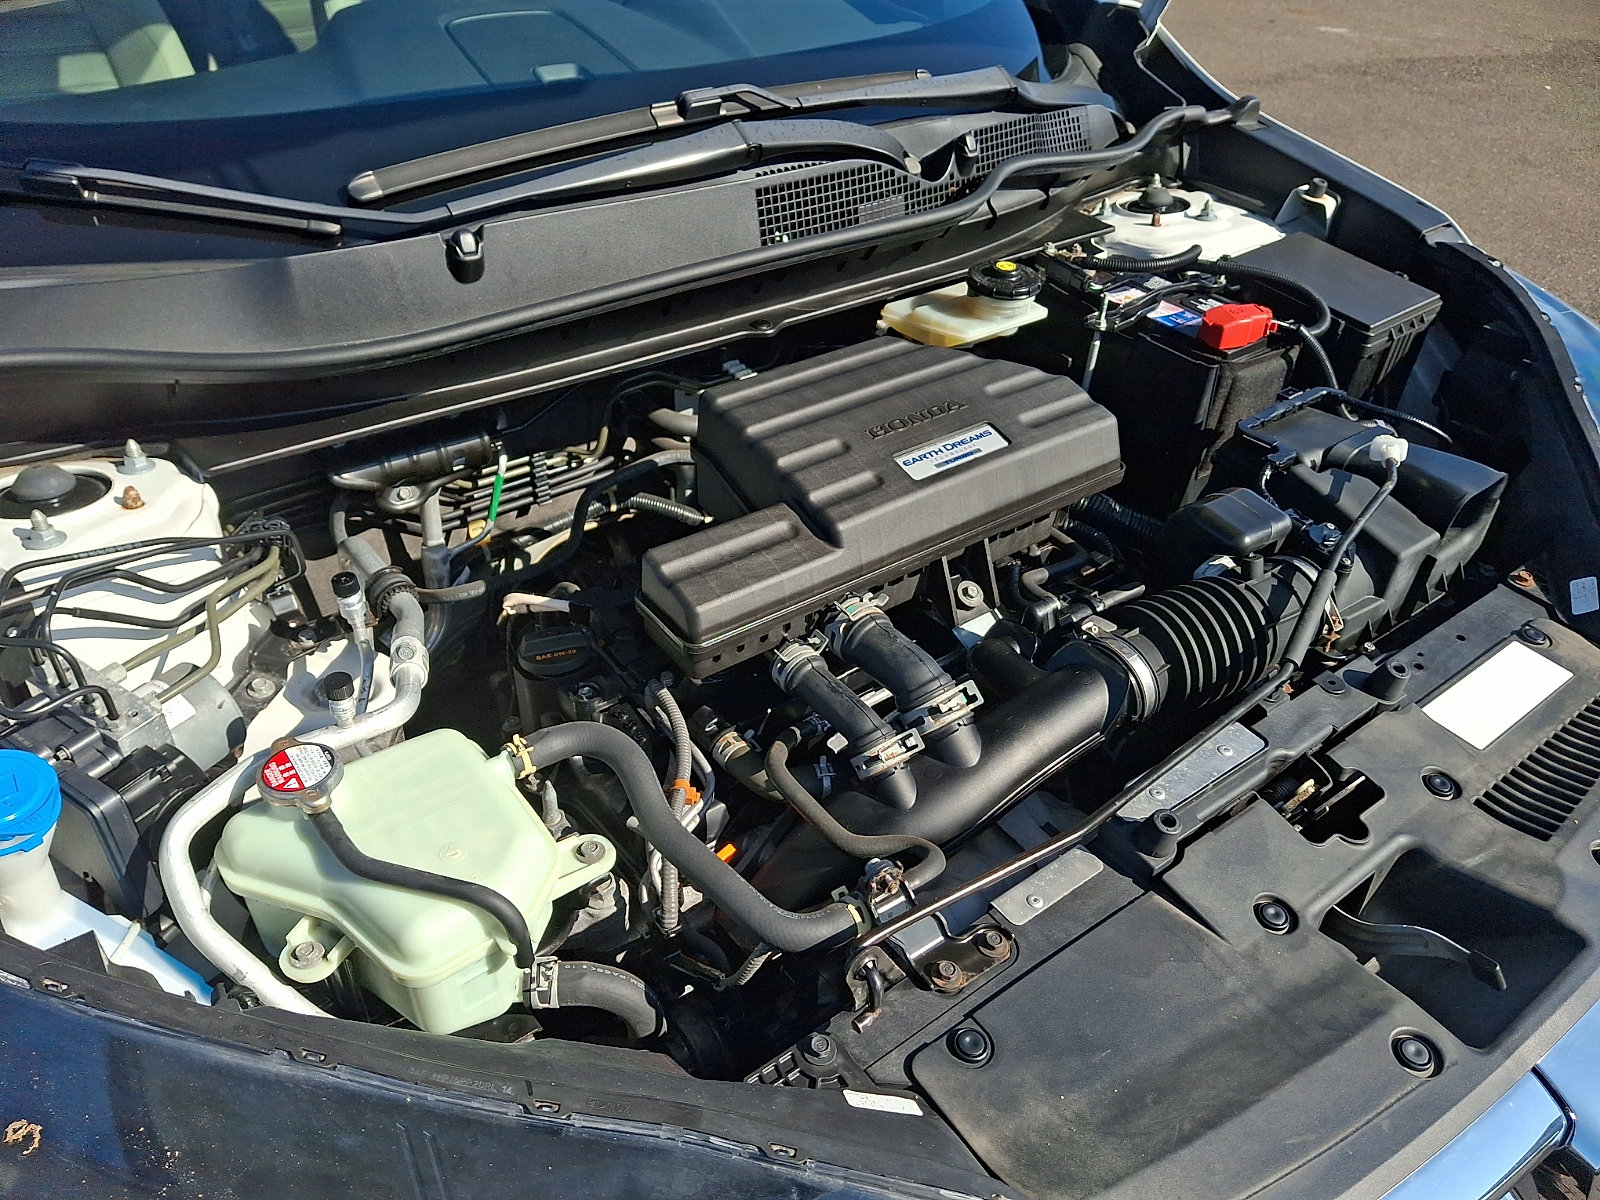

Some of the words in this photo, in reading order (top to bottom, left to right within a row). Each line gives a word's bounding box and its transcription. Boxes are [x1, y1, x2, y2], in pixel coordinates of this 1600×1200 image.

[864, 399, 968, 440] HONDA
[902, 448, 943, 467] EARTH
[942, 430, 992, 452] DREAMS
[943, 451, 974, 465] TURBO
[535, 653, 552, 661] SAE
[553, 649, 577, 657] 0W-20
